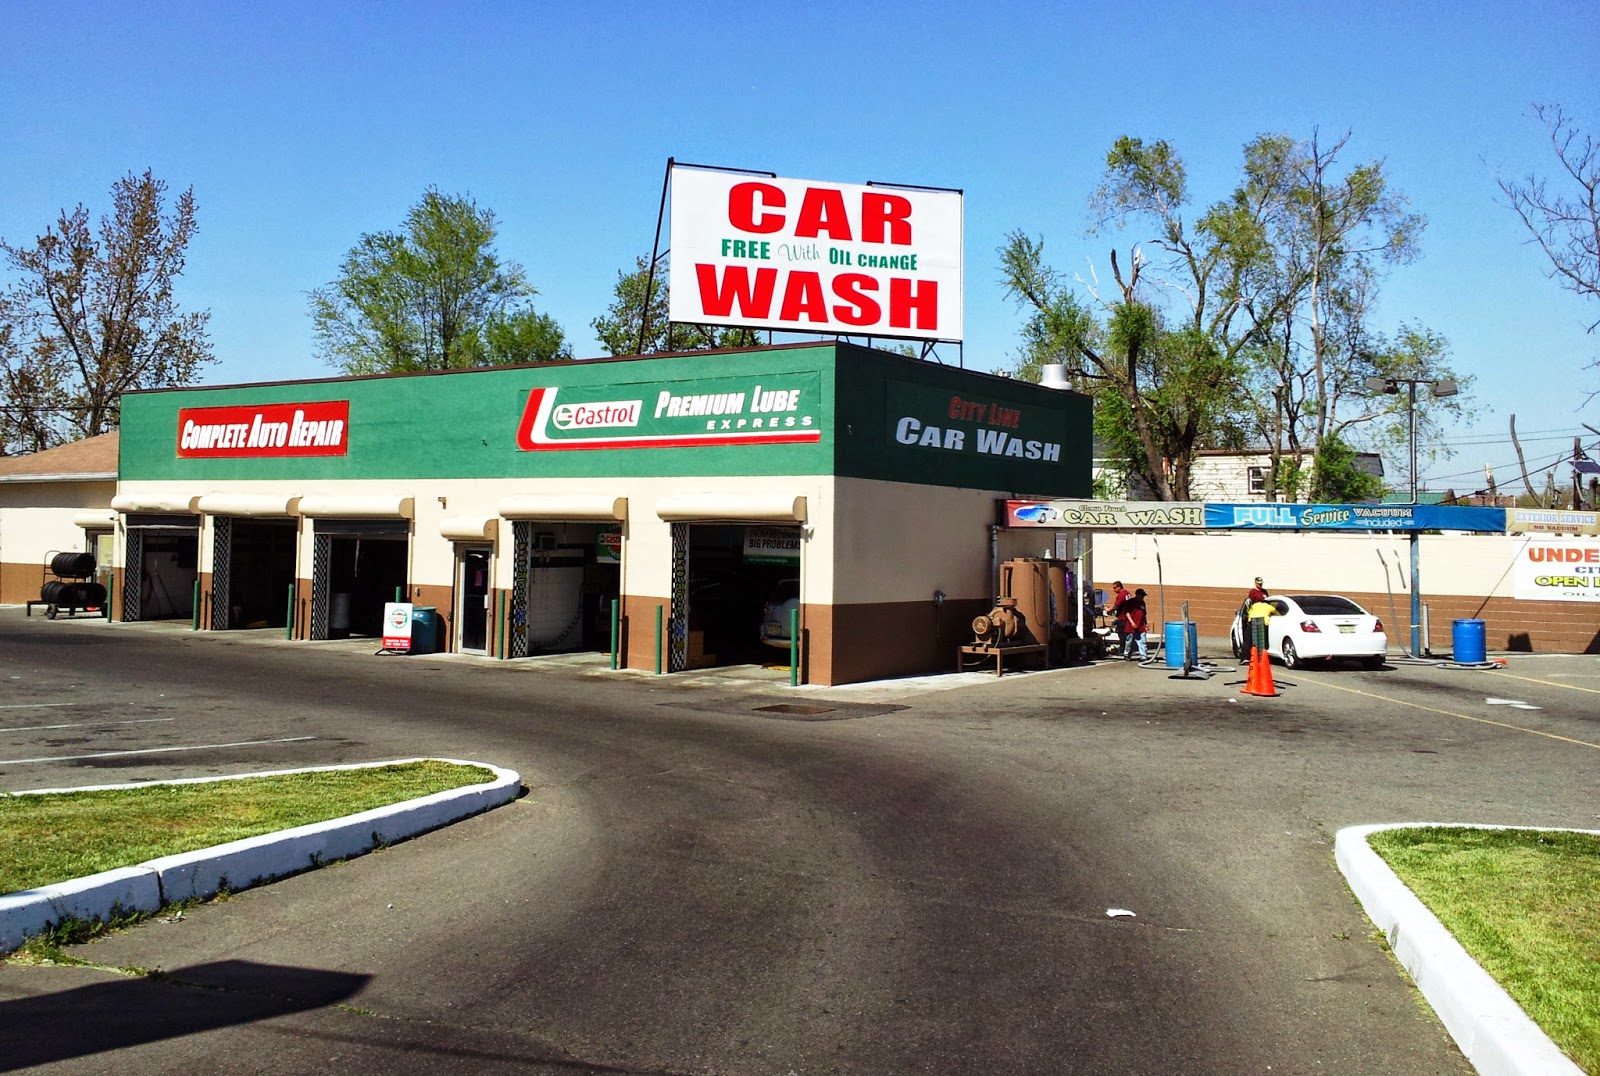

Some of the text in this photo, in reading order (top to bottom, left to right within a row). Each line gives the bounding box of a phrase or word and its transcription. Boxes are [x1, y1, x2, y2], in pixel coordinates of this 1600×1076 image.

[728, 181, 912, 246] CAR
[721, 238, 918, 271] FREE With OIL CHANGE
[695, 263, 938, 331] WASH
[654, 385, 801, 418] PREMIUM LUBE
[575, 405, 635, 425] Castrol
[948, 396, 1022, 429] CITY LINE
[180, 409, 345, 450] COMPLETE AUTO REPAIR
[706, 415, 813, 431] EXPRESS
[895, 416, 1061, 462] CAR WASH
[1063, 506, 1203, 526] CAR WASH
[1233, 506, 1350, 527] FULL Service
[1352, 507, 1413, 519] VACUUM
[1364, 517, 1403, 527] Included
[1515, 512, 1596, 524] EXTERIOR SERVICE
[749, 538, 761, 548] BIG
[1528, 547, 1600, 563] UNDE
[1534, 575, 1589, 588] OPEN
